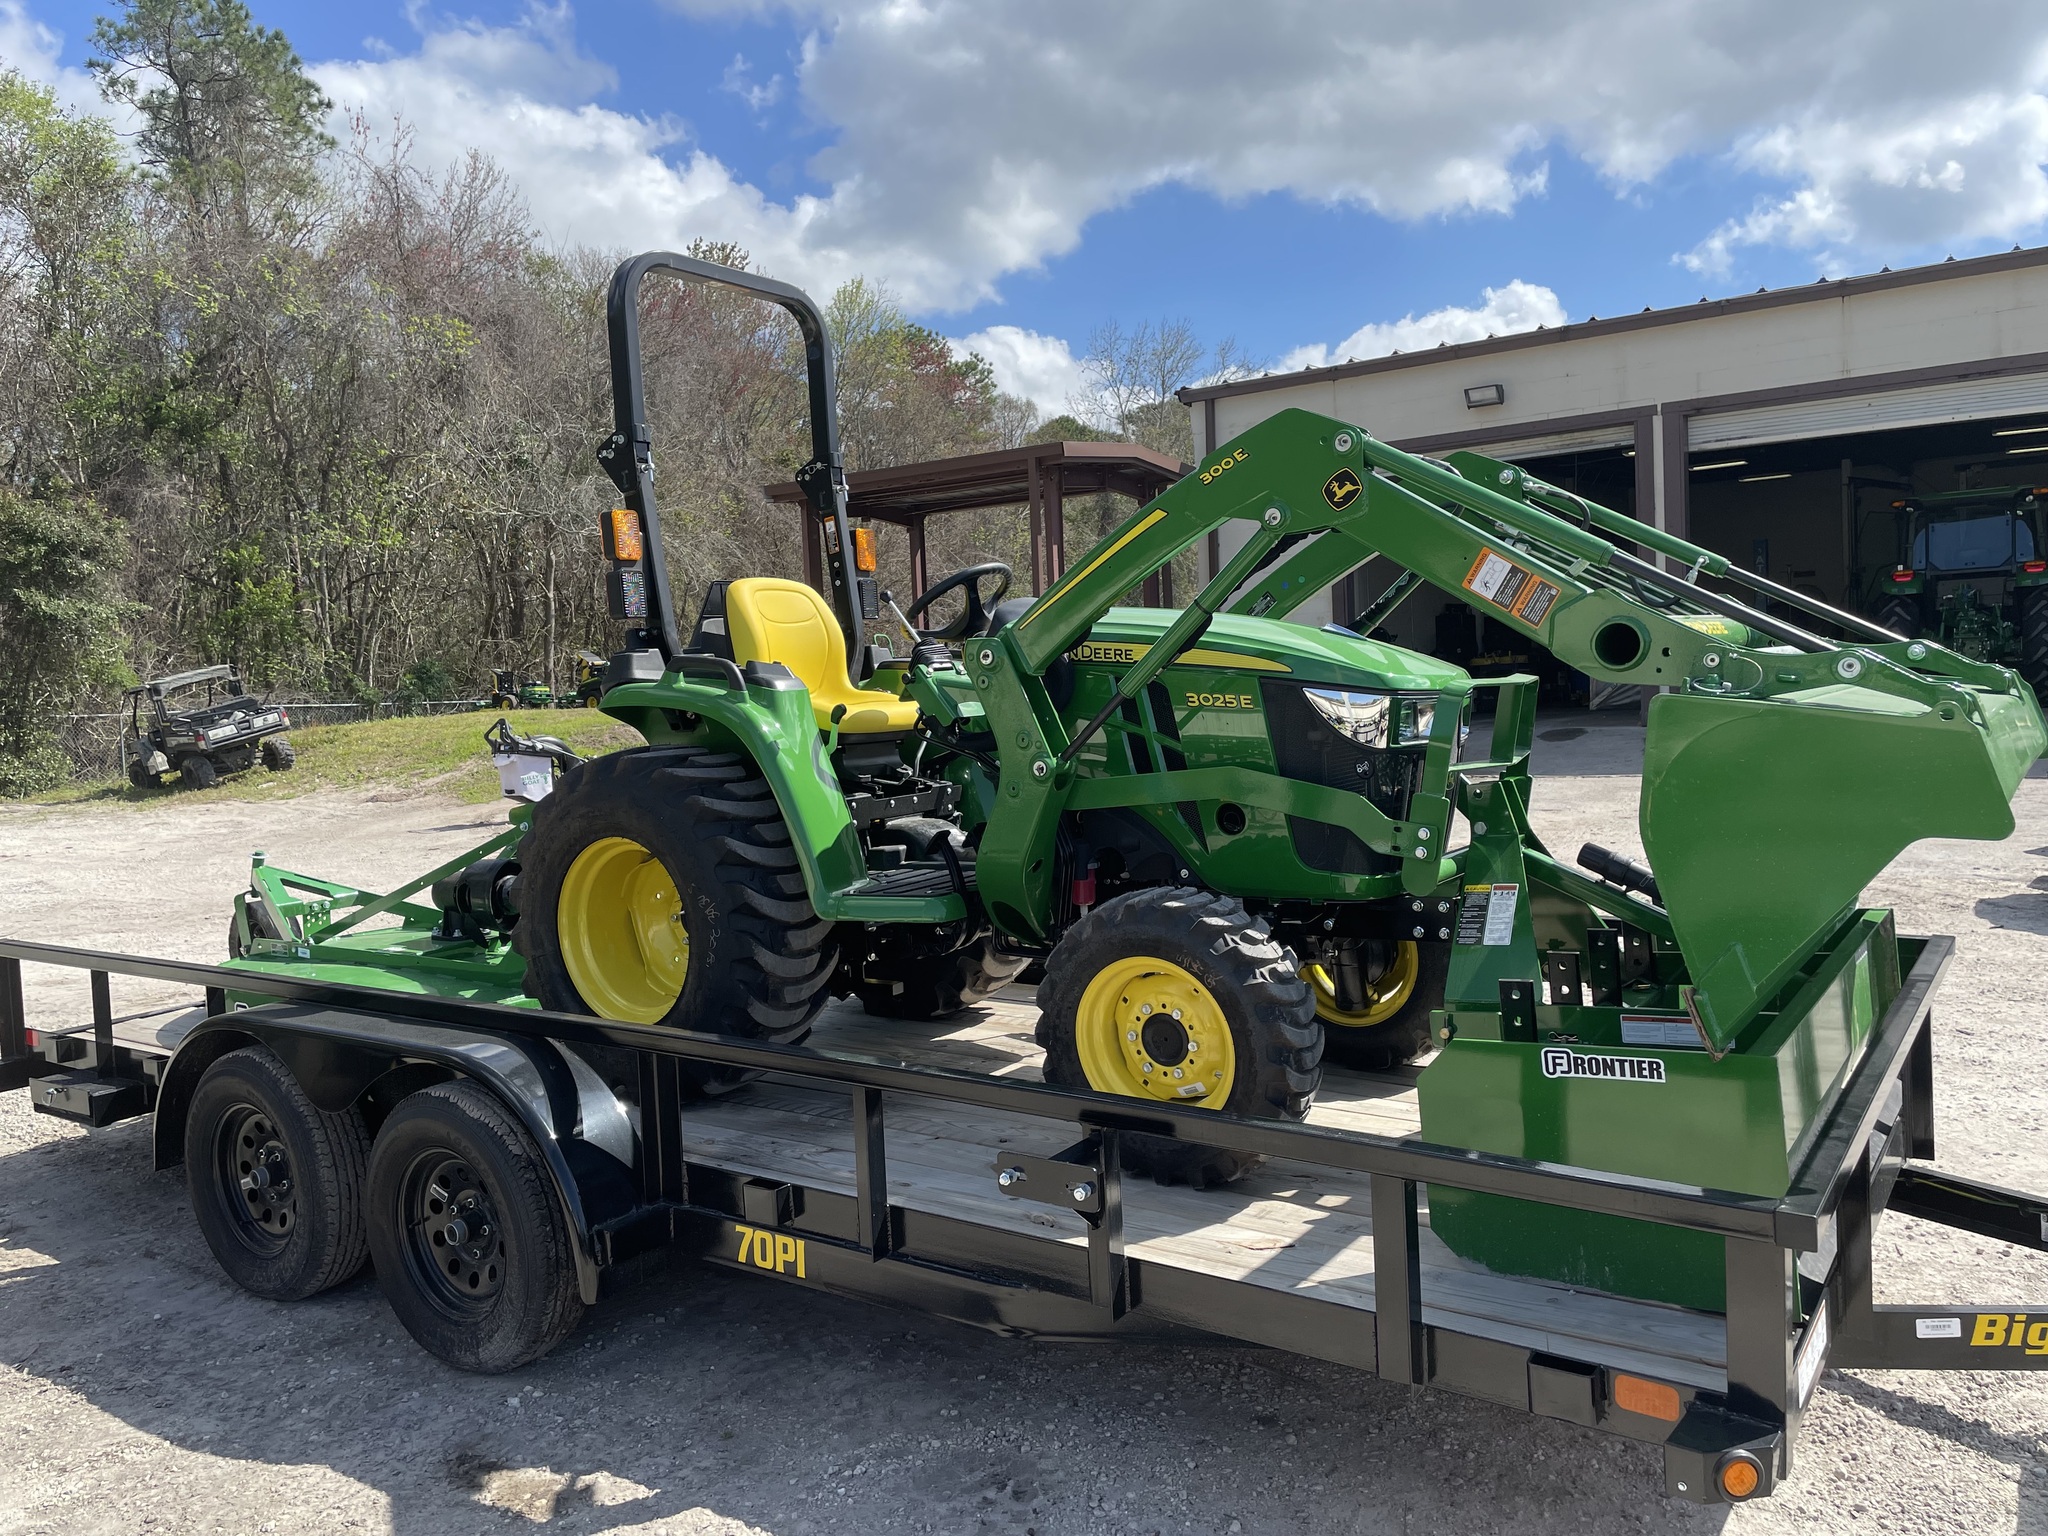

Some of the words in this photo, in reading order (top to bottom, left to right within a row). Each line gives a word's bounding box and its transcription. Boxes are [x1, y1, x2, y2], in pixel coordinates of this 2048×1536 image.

[1470, 552, 1487, 578] WARNING
[1521, 580, 1538, 606] WARNING
[1081, 644, 1134, 661] DEERE
[1543, 1049, 1664, 1080] FRONTIER
[735, 1224, 806, 1279] 70PI
[1970, 1314, 2048, 1355] Big
